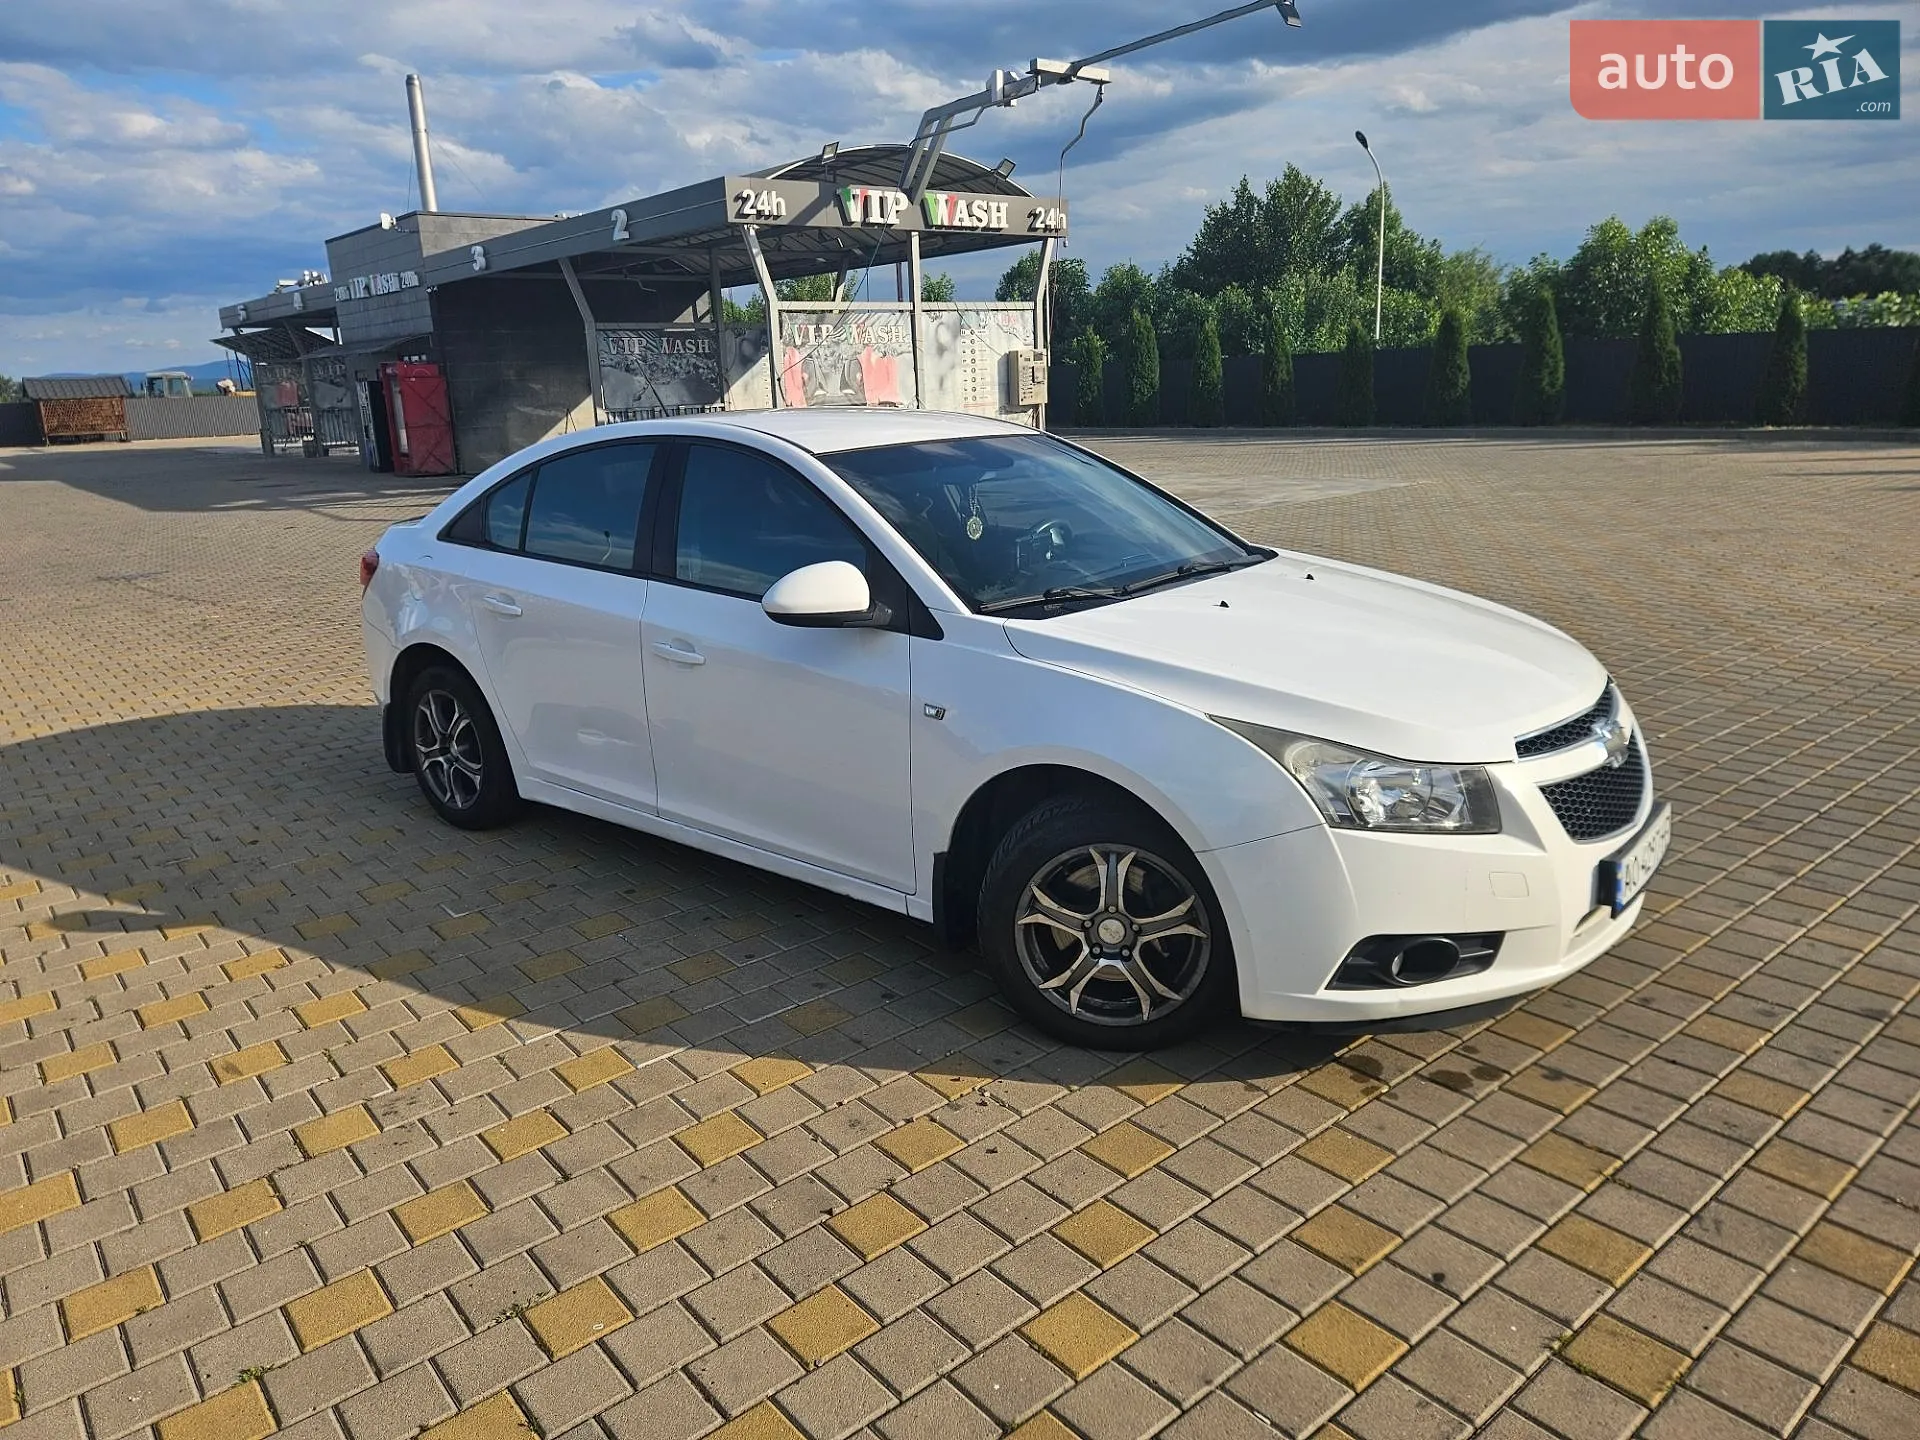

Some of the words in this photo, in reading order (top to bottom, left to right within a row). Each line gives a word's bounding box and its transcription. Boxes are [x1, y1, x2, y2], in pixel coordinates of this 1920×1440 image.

[738, 189, 787, 216] 24h
[838, 187, 909, 225] VIP
[923, 193, 1009, 229] WASH
[1034, 207, 1067, 230] 24h
[611, 209, 630, 241] 2
[471, 245, 487, 271] 3
[608, 337, 648, 355] VIP
[658, 336, 710, 354] WASH
[789, 323, 834, 346] VIP
[845, 321, 905, 345] WASH
